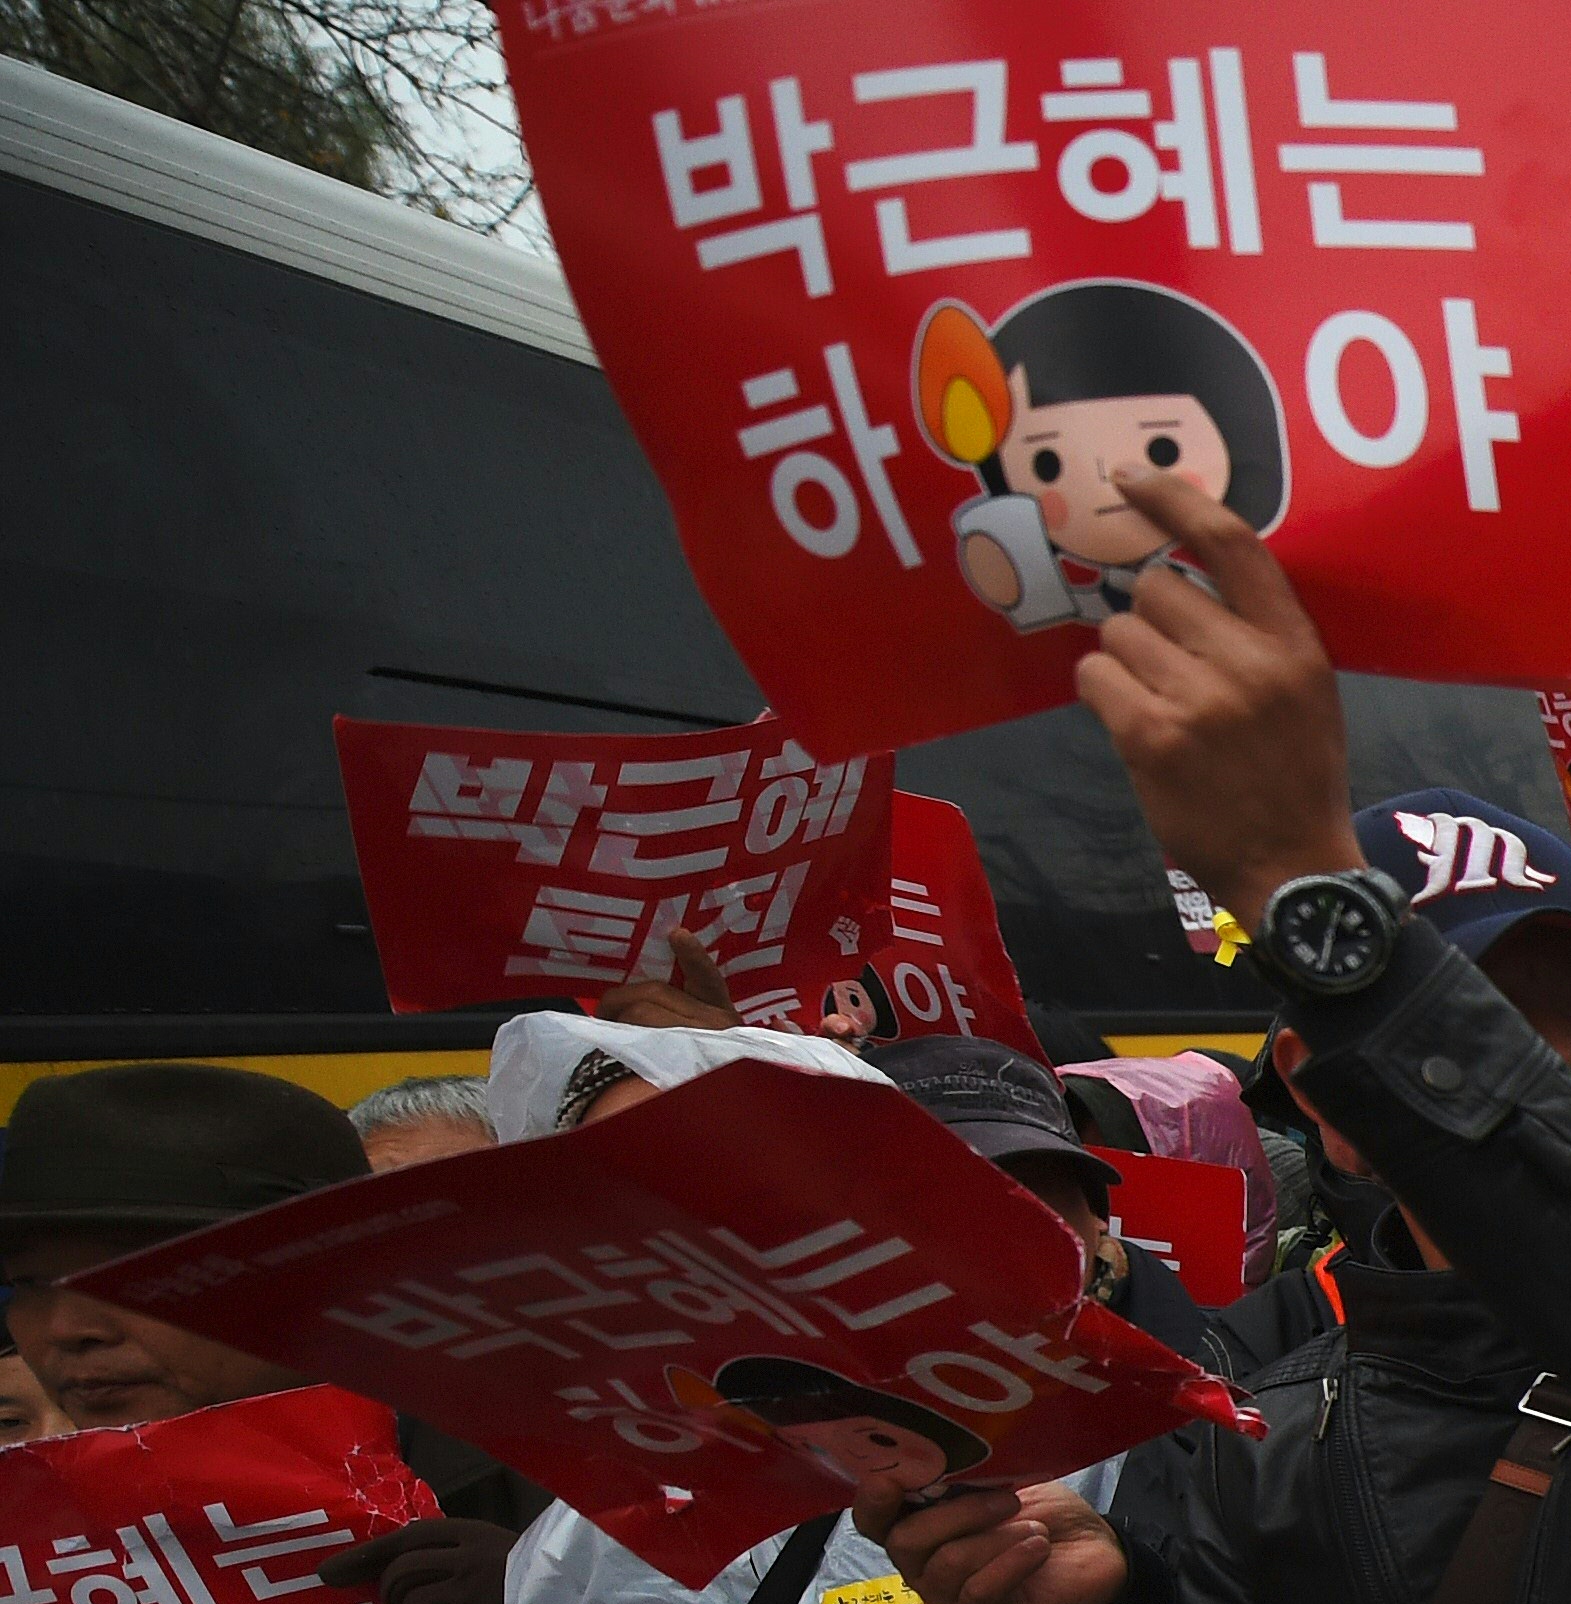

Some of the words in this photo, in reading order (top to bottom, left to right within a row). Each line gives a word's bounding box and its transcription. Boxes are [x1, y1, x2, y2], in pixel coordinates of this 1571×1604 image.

[652, 46, 1484, 298] 박근혜는
[735, 341, 924, 569] 하
[1304, 297, 1521, 513] 야
[405, 738, 868, 882] 박근혜
[322, 1219, 955, 1361] 박근혜는
